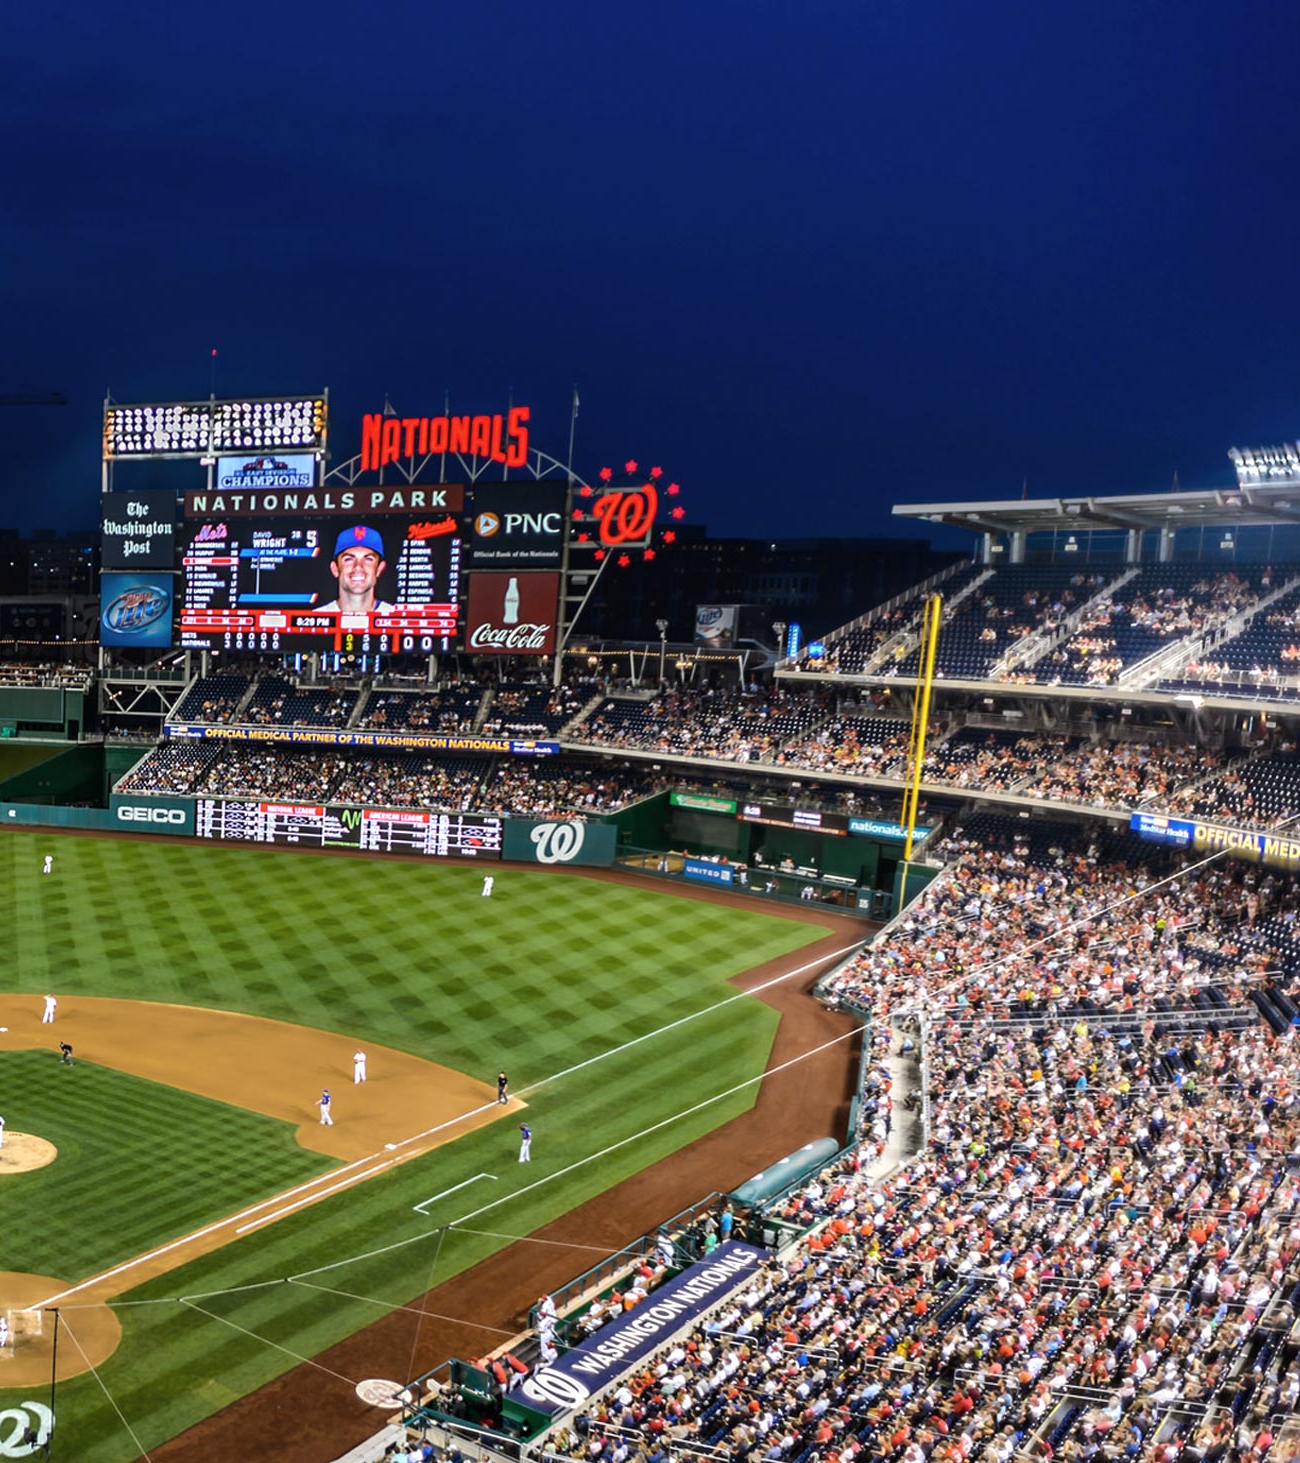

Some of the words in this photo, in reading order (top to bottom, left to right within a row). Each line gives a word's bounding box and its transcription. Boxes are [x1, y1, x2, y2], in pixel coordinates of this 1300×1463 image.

[361, 406, 530, 471] NATIONALS
[220, 474, 310, 488] CHAMPIONS
[127, 501, 149, 518] The
[193, 493, 355, 511] NATIONALS
[371, 490, 447, 508] PARK
[103, 518, 172, 538] Washington
[194, 522, 228, 542] Mets
[504, 512, 561, 534] PNC
[123, 540, 150, 557] Post
[252, 538, 287, 548] WRIGHT
[253, 531, 272, 539] DAVID
[306, 530, 317, 547] 5
[113, 598, 161, 629] Lite
[296, 617, 315, 626] 8:29
[316, 617, 329, 626] PM
[404, 636, 413, 650] 0
[422, 636, 432, 650] 0
[204, 729, 244, 741] OFFICIAL
[247, 730, 290, 742] MEDICAL
[292, 732, 336, 743] PARTNER
[337, 734, 351, 743] OF
[354, 734, 373, 744] THE
[375, 736, 447, 749] WASHINGTON
[448, 739, 510, 751] NATIONALS
[117, 805, 186, 825] GEICO
[369, 813, 400, 821] AMERICAN
[401, 814, 424, 822] LEAGUE
[1194, 826, 1262, 852] OFFICIAL
[686, 865, 721, 878] UNITED
[572, 1297, 681, 1375] WASHINGTON
[671, 1247, 758, 1311] NATIONALS
